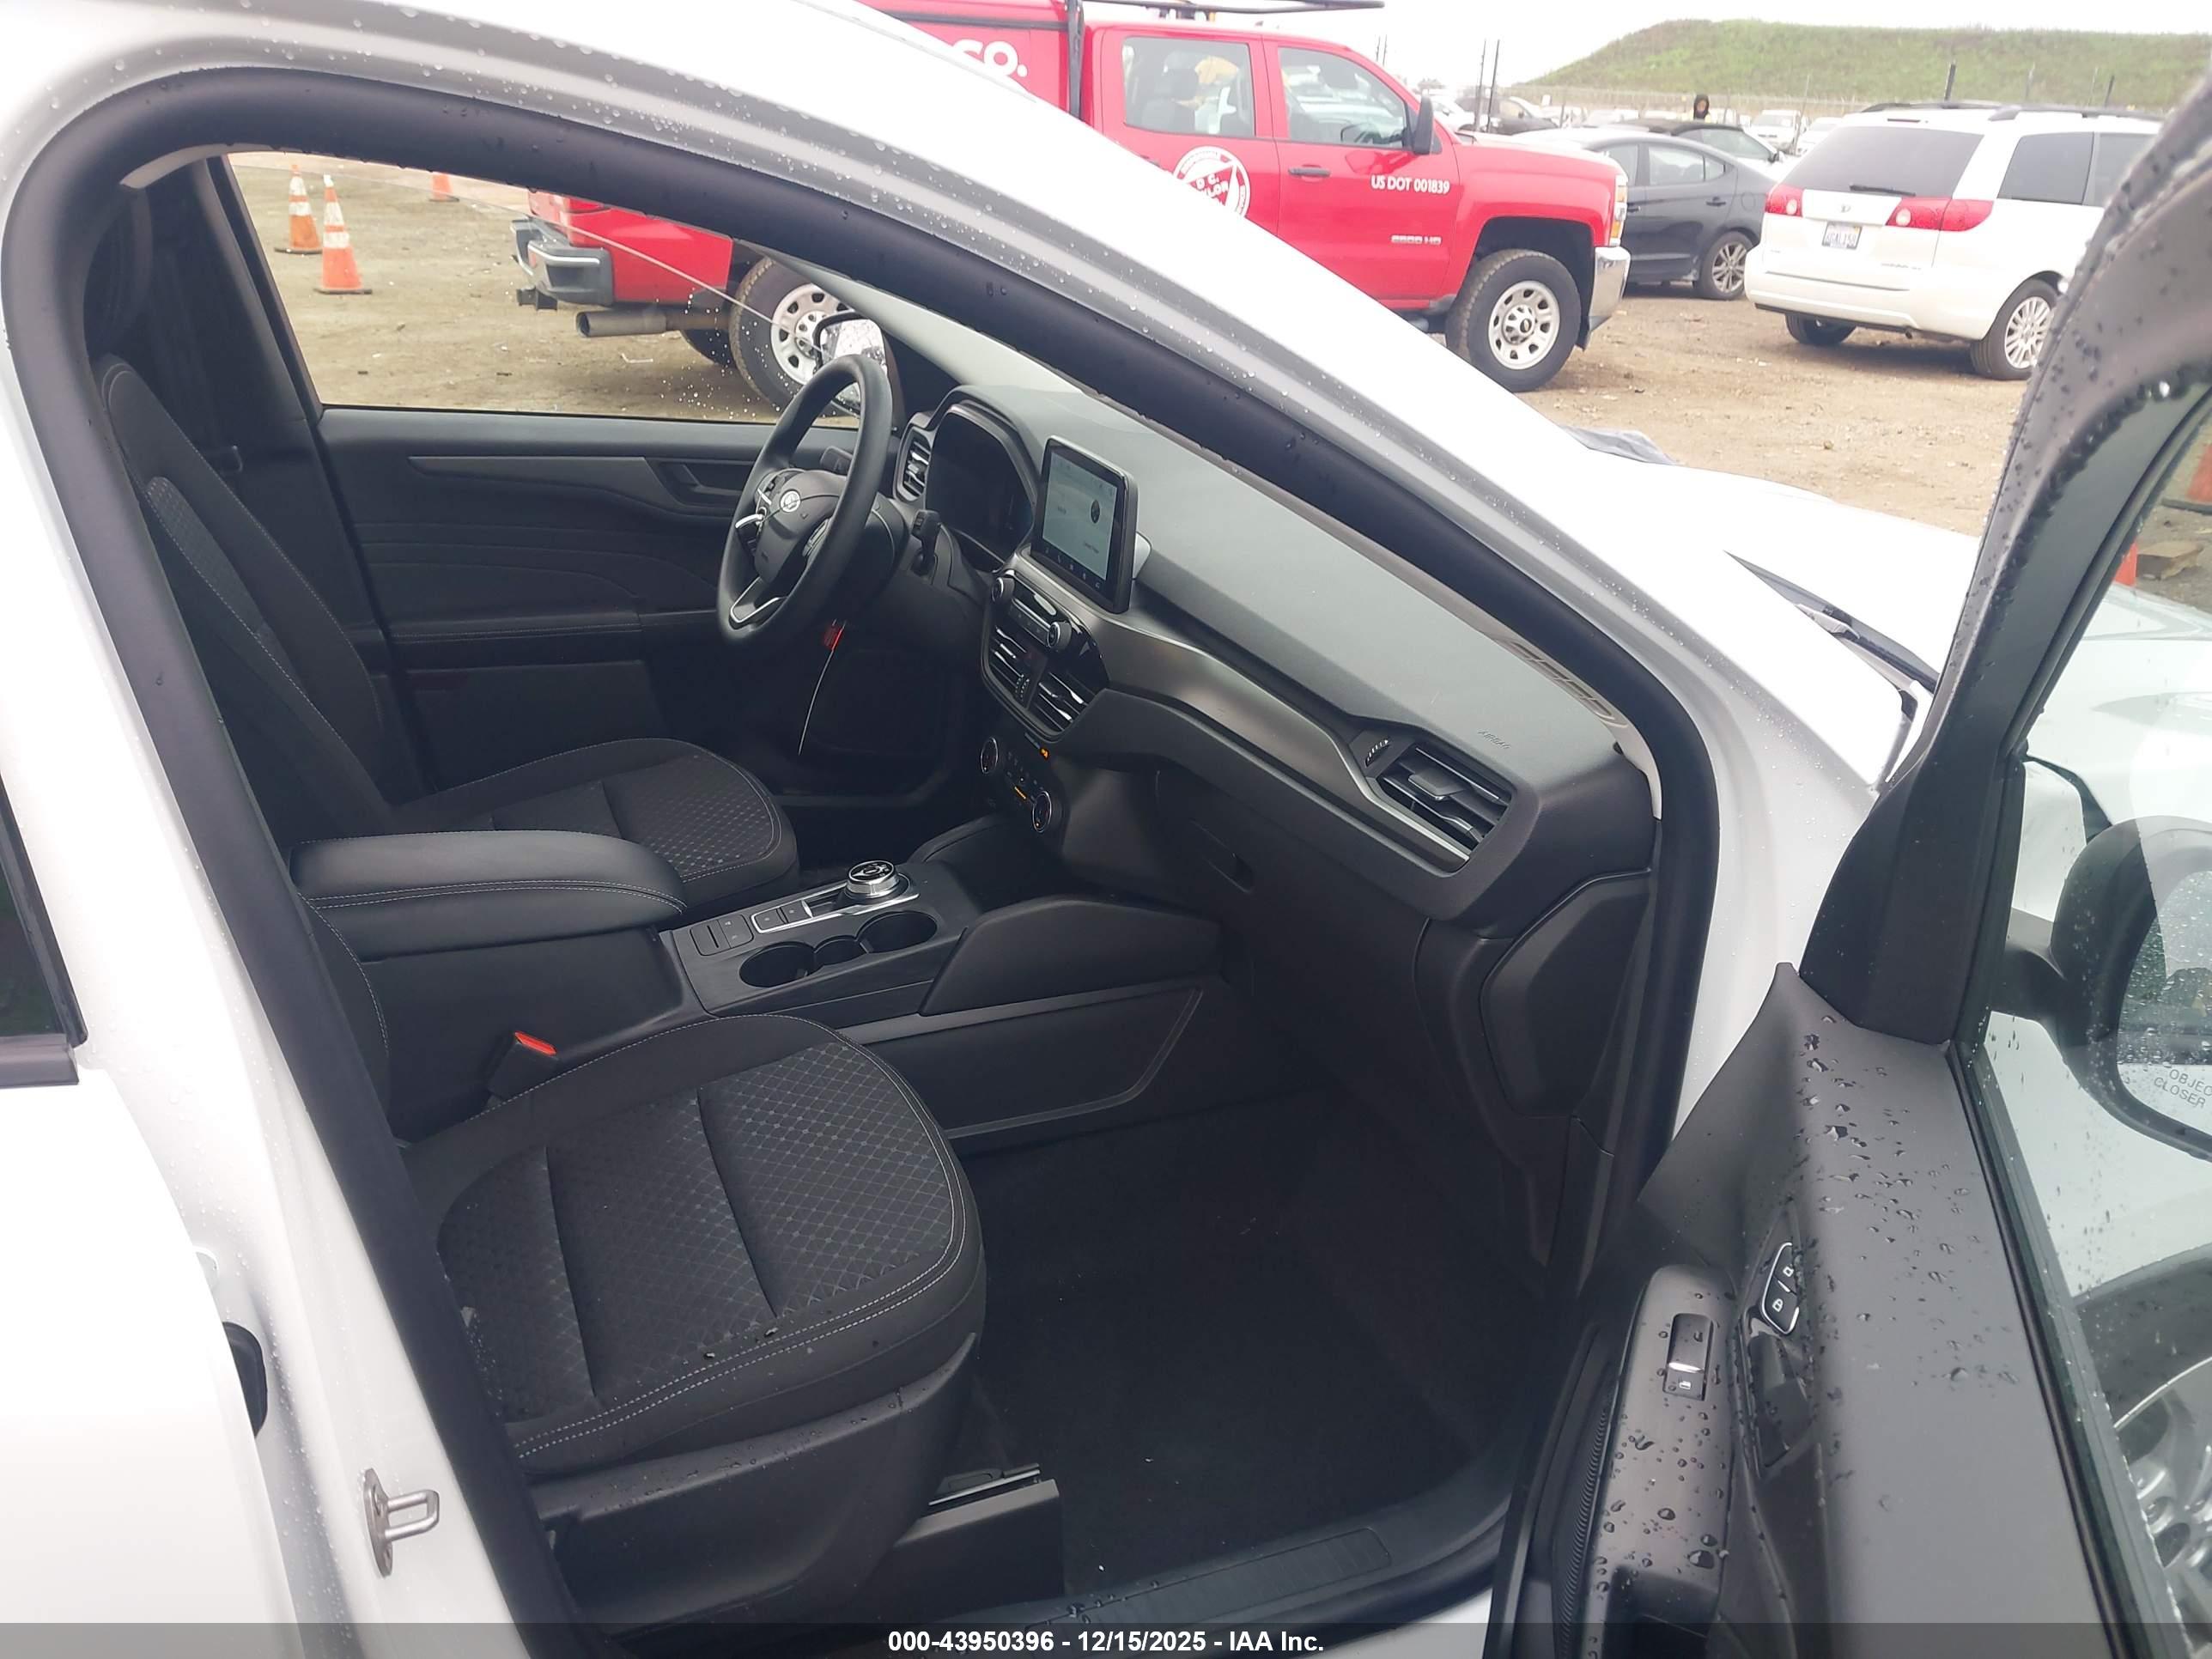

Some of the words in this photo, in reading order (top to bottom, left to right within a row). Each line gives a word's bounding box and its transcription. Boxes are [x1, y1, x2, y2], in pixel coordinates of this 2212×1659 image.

[1370, 174, 1386, 189] US
[1387, 175, 1413, 191] DOT
[1413, 178, 1450, 195] 001839
[2154, 1077, 2206, 1109] CLOSER
